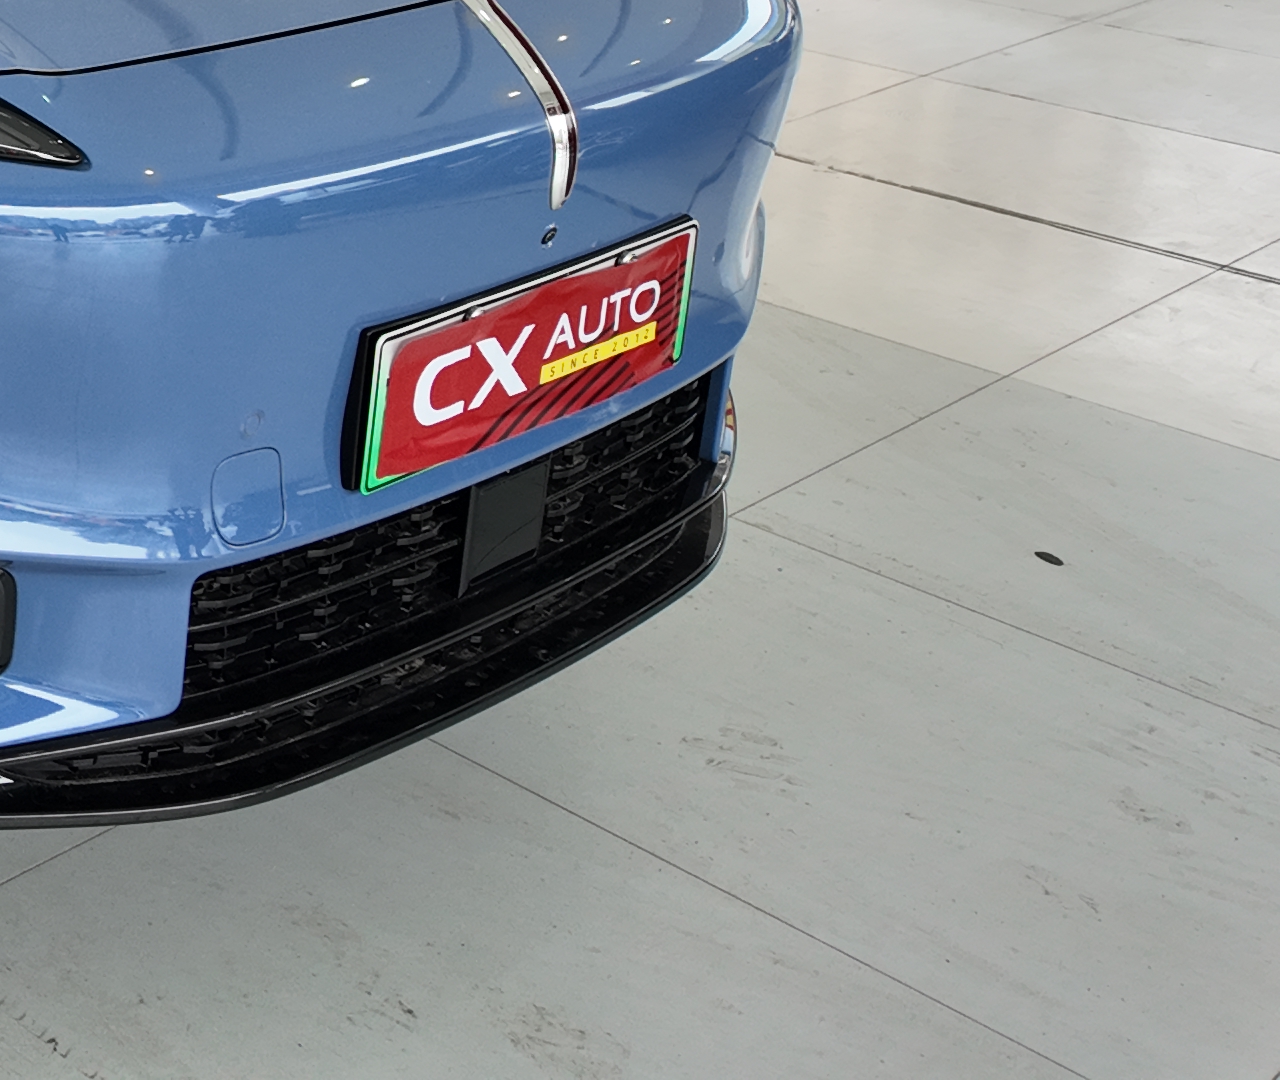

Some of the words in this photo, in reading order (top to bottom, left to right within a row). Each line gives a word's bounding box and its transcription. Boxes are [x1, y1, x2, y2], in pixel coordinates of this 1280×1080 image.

[412, 323, 536, 427] CX
[543, 279, 661, 360] AUTO
[548, 347, 600, 379] SINCE
[610, 327, 651, 354] 2012
